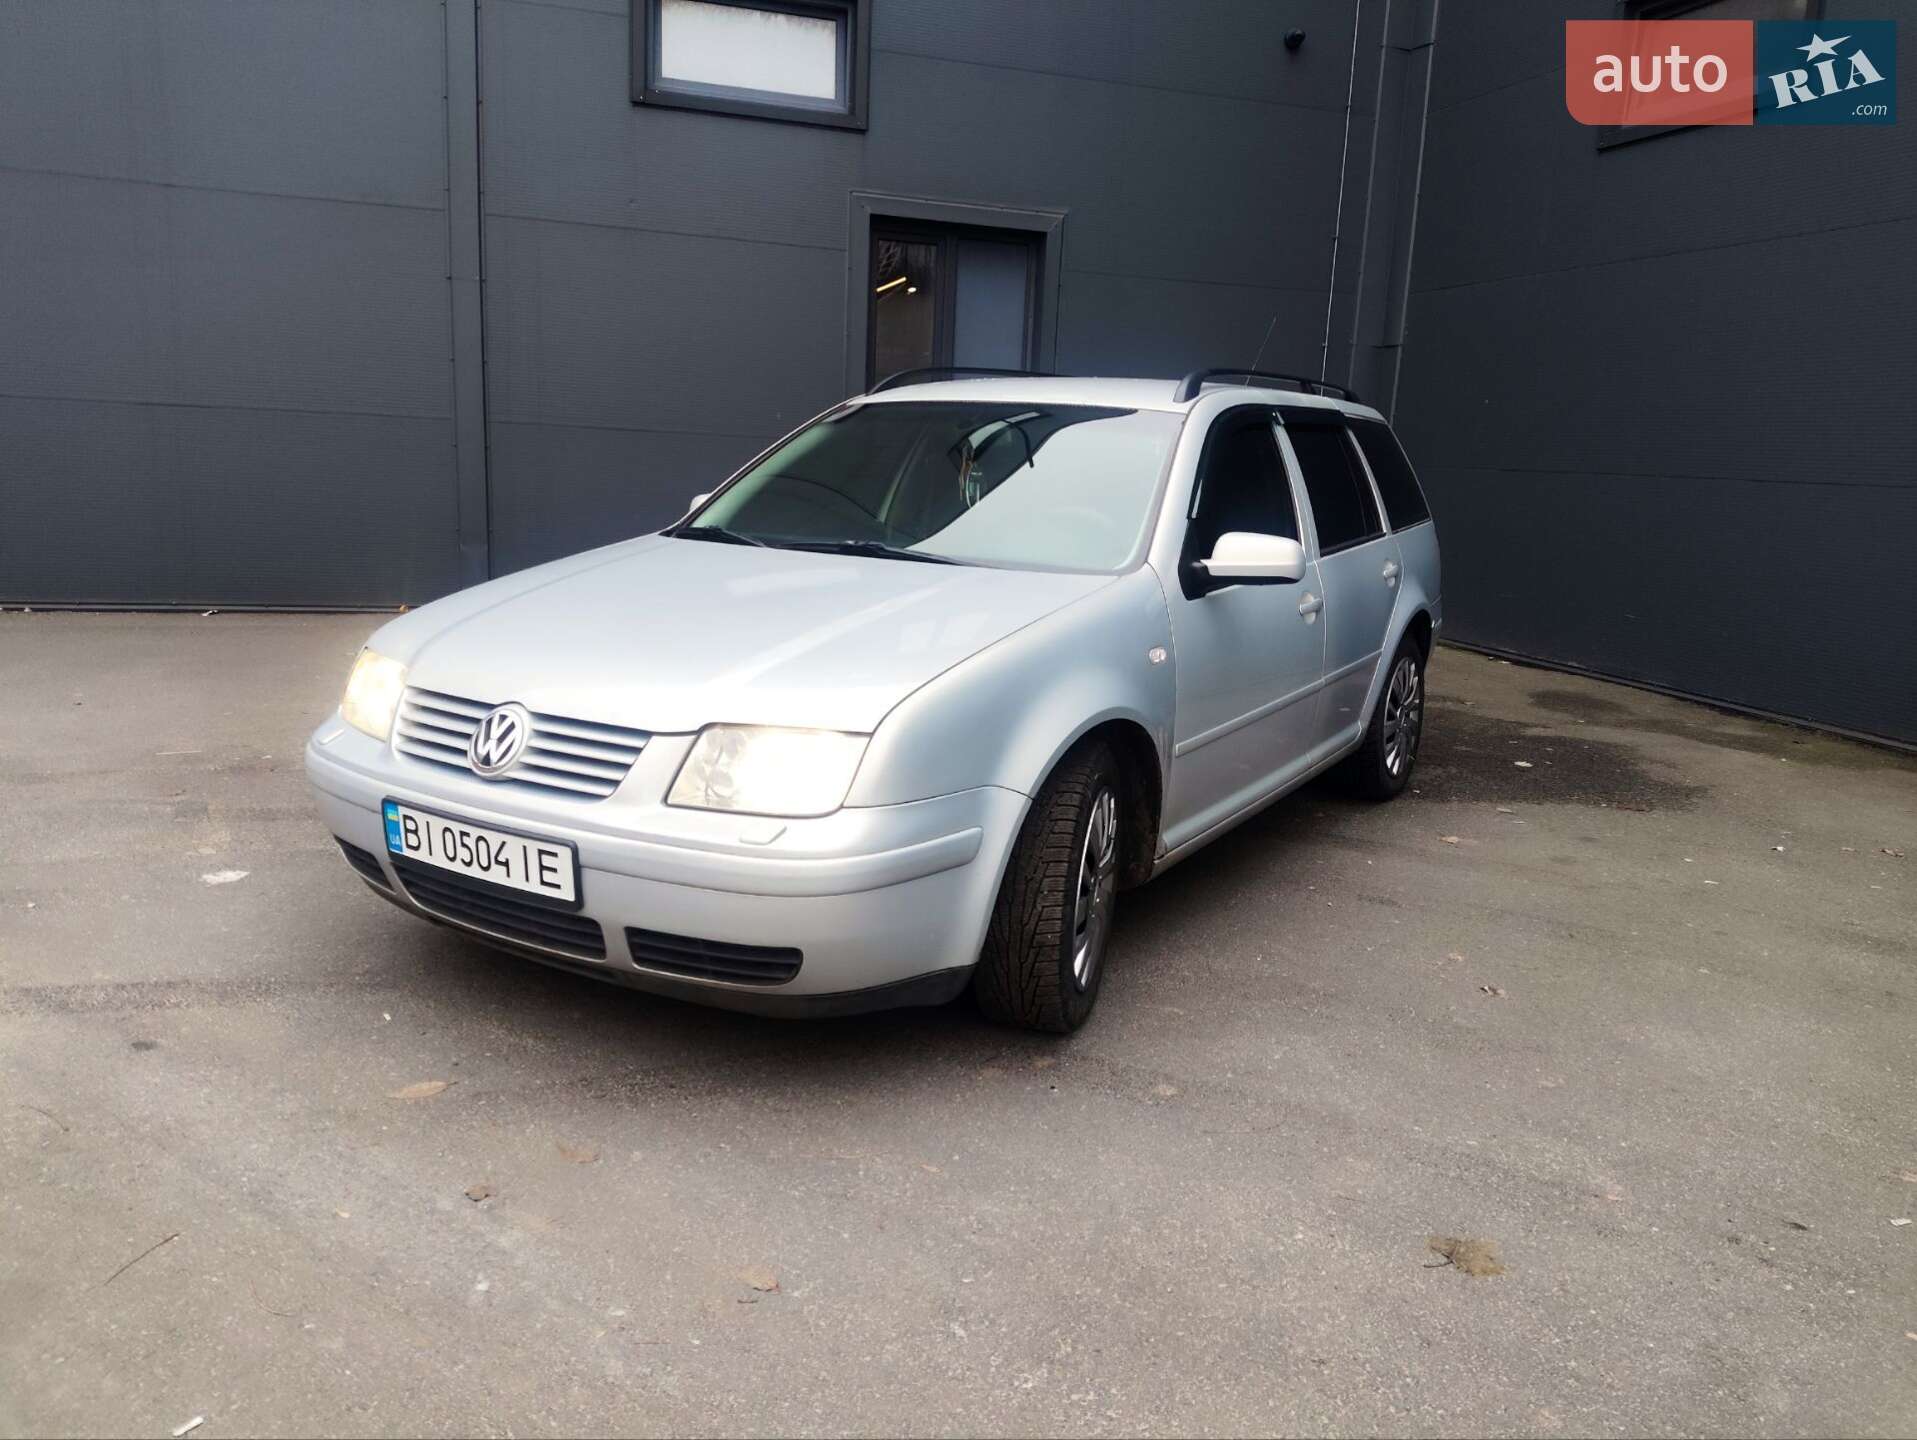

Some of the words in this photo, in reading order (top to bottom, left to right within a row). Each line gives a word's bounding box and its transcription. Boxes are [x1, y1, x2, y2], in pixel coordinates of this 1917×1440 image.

[402, 814, 434, 857] BI
[441, 826, 511, 878] 0504
[522, 844, 562, 890] IE
